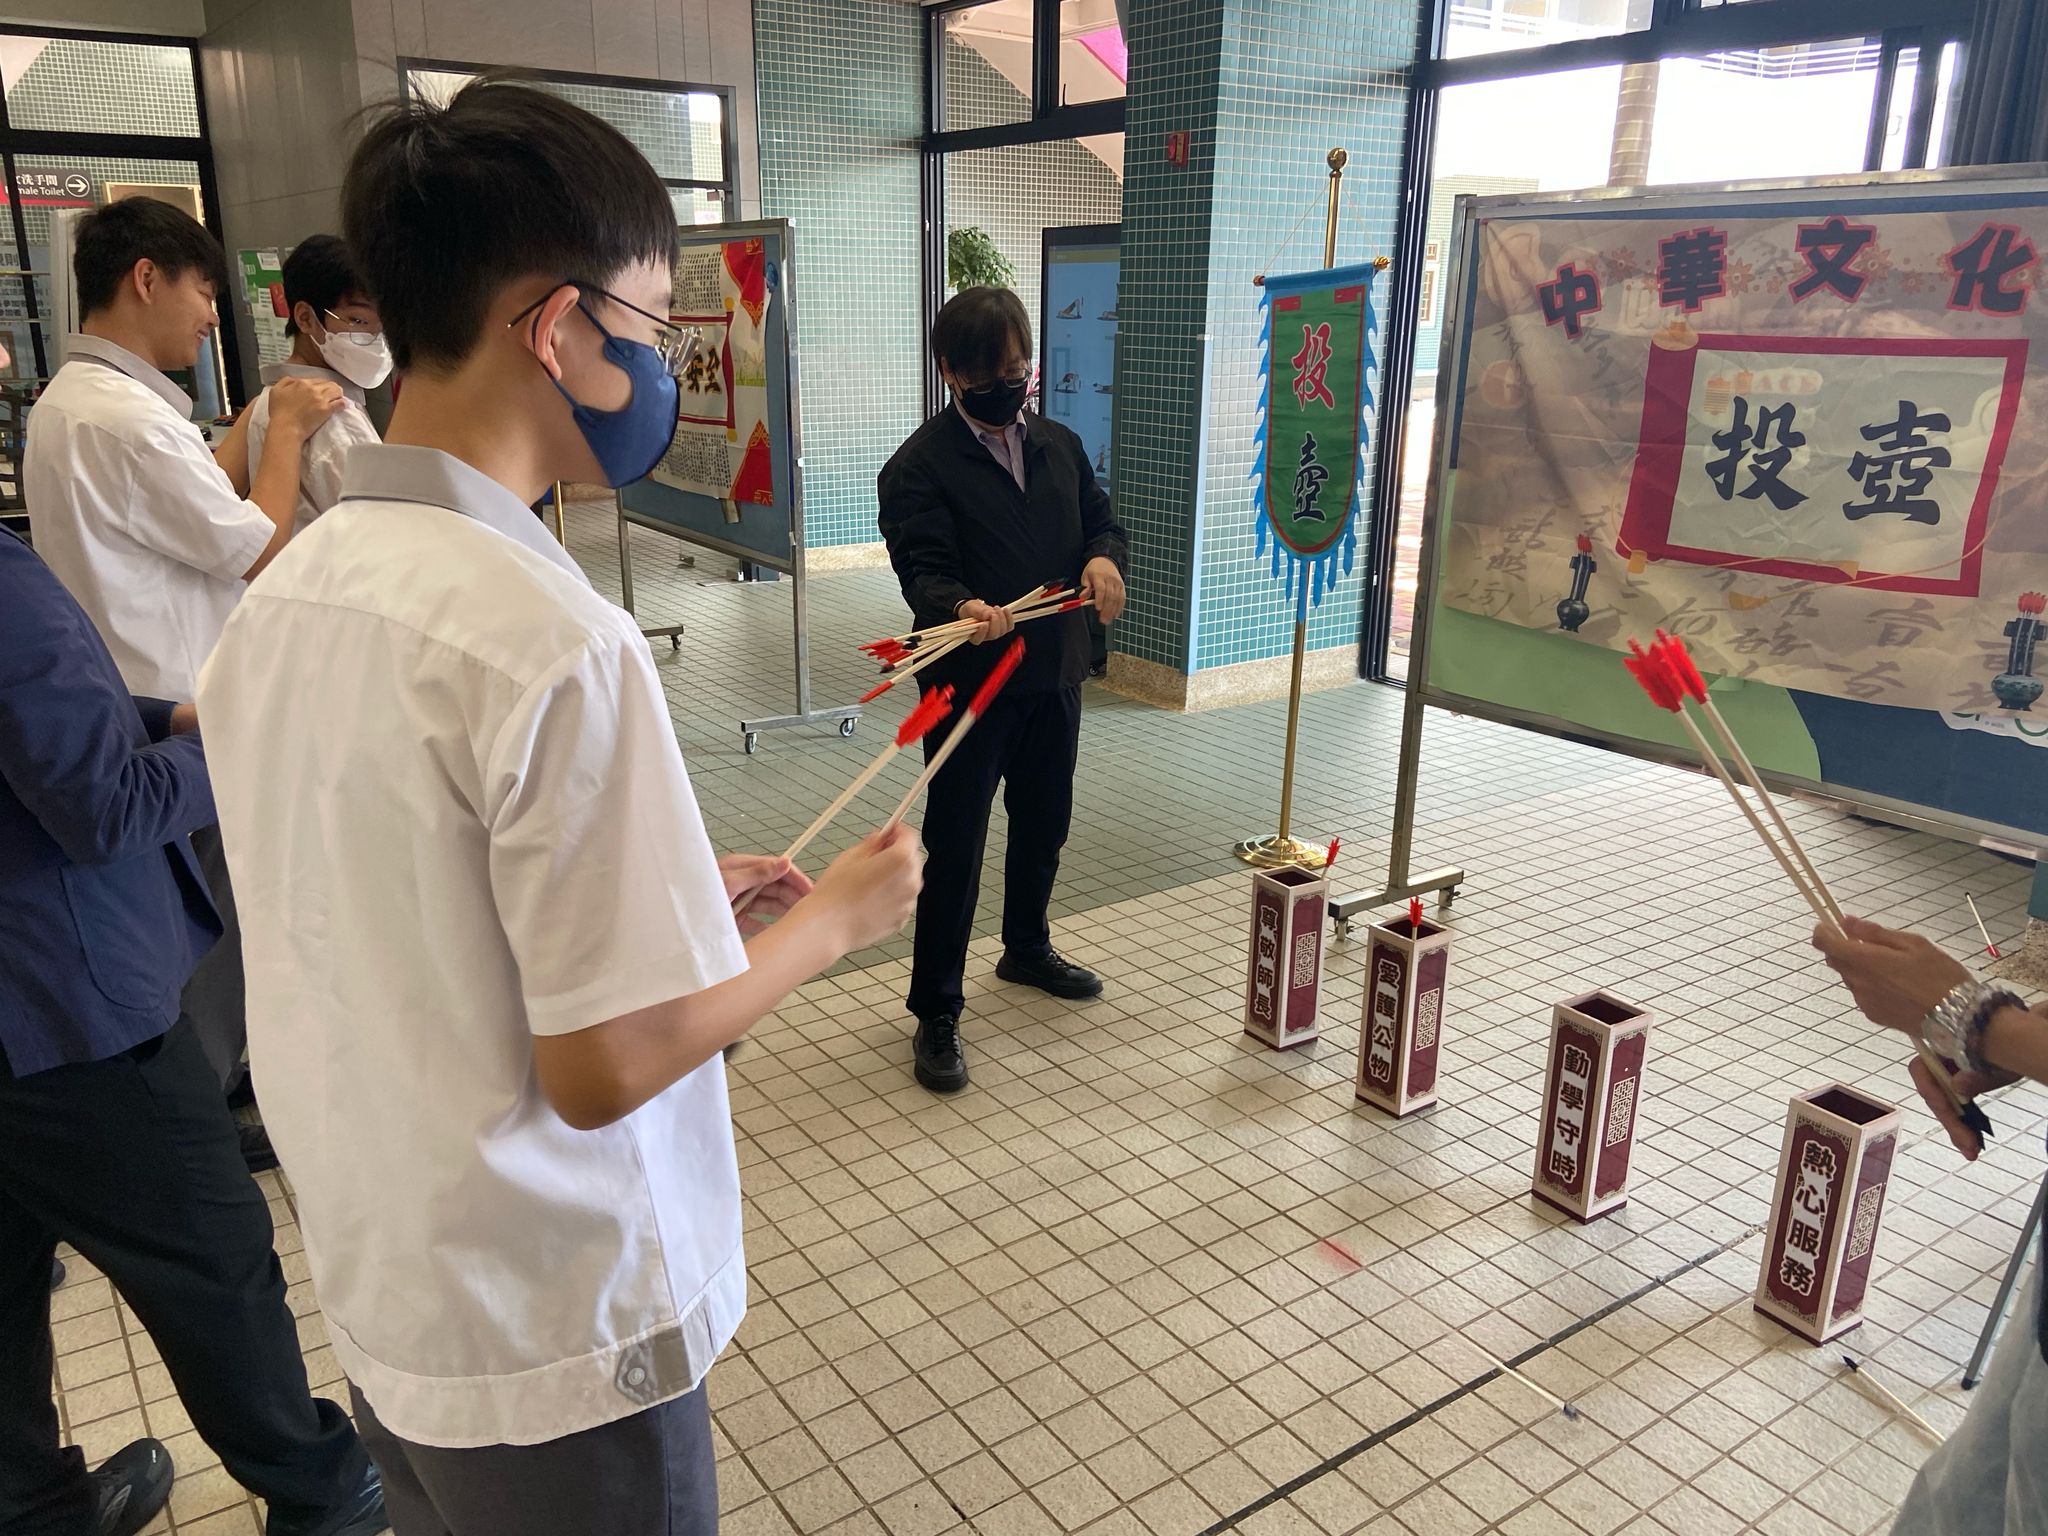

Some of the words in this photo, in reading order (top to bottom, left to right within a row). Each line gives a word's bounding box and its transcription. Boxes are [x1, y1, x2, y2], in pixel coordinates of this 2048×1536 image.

[40, 187, 65, 196] Toilet
[1537, 216, 2039, 340] 中華文化
[1290, 322, 1335, 523] 投壺
[1705, 396, 1952, 526] 投壺
[1255, 905, 1279, 1021] 尊敬師長
[1368, 958, 1401, 1083] 愛護公物
[1550, 1044, 1592, 1184] 勤學守時
[1779, 1140, 1837, 1296] 熱心服務
